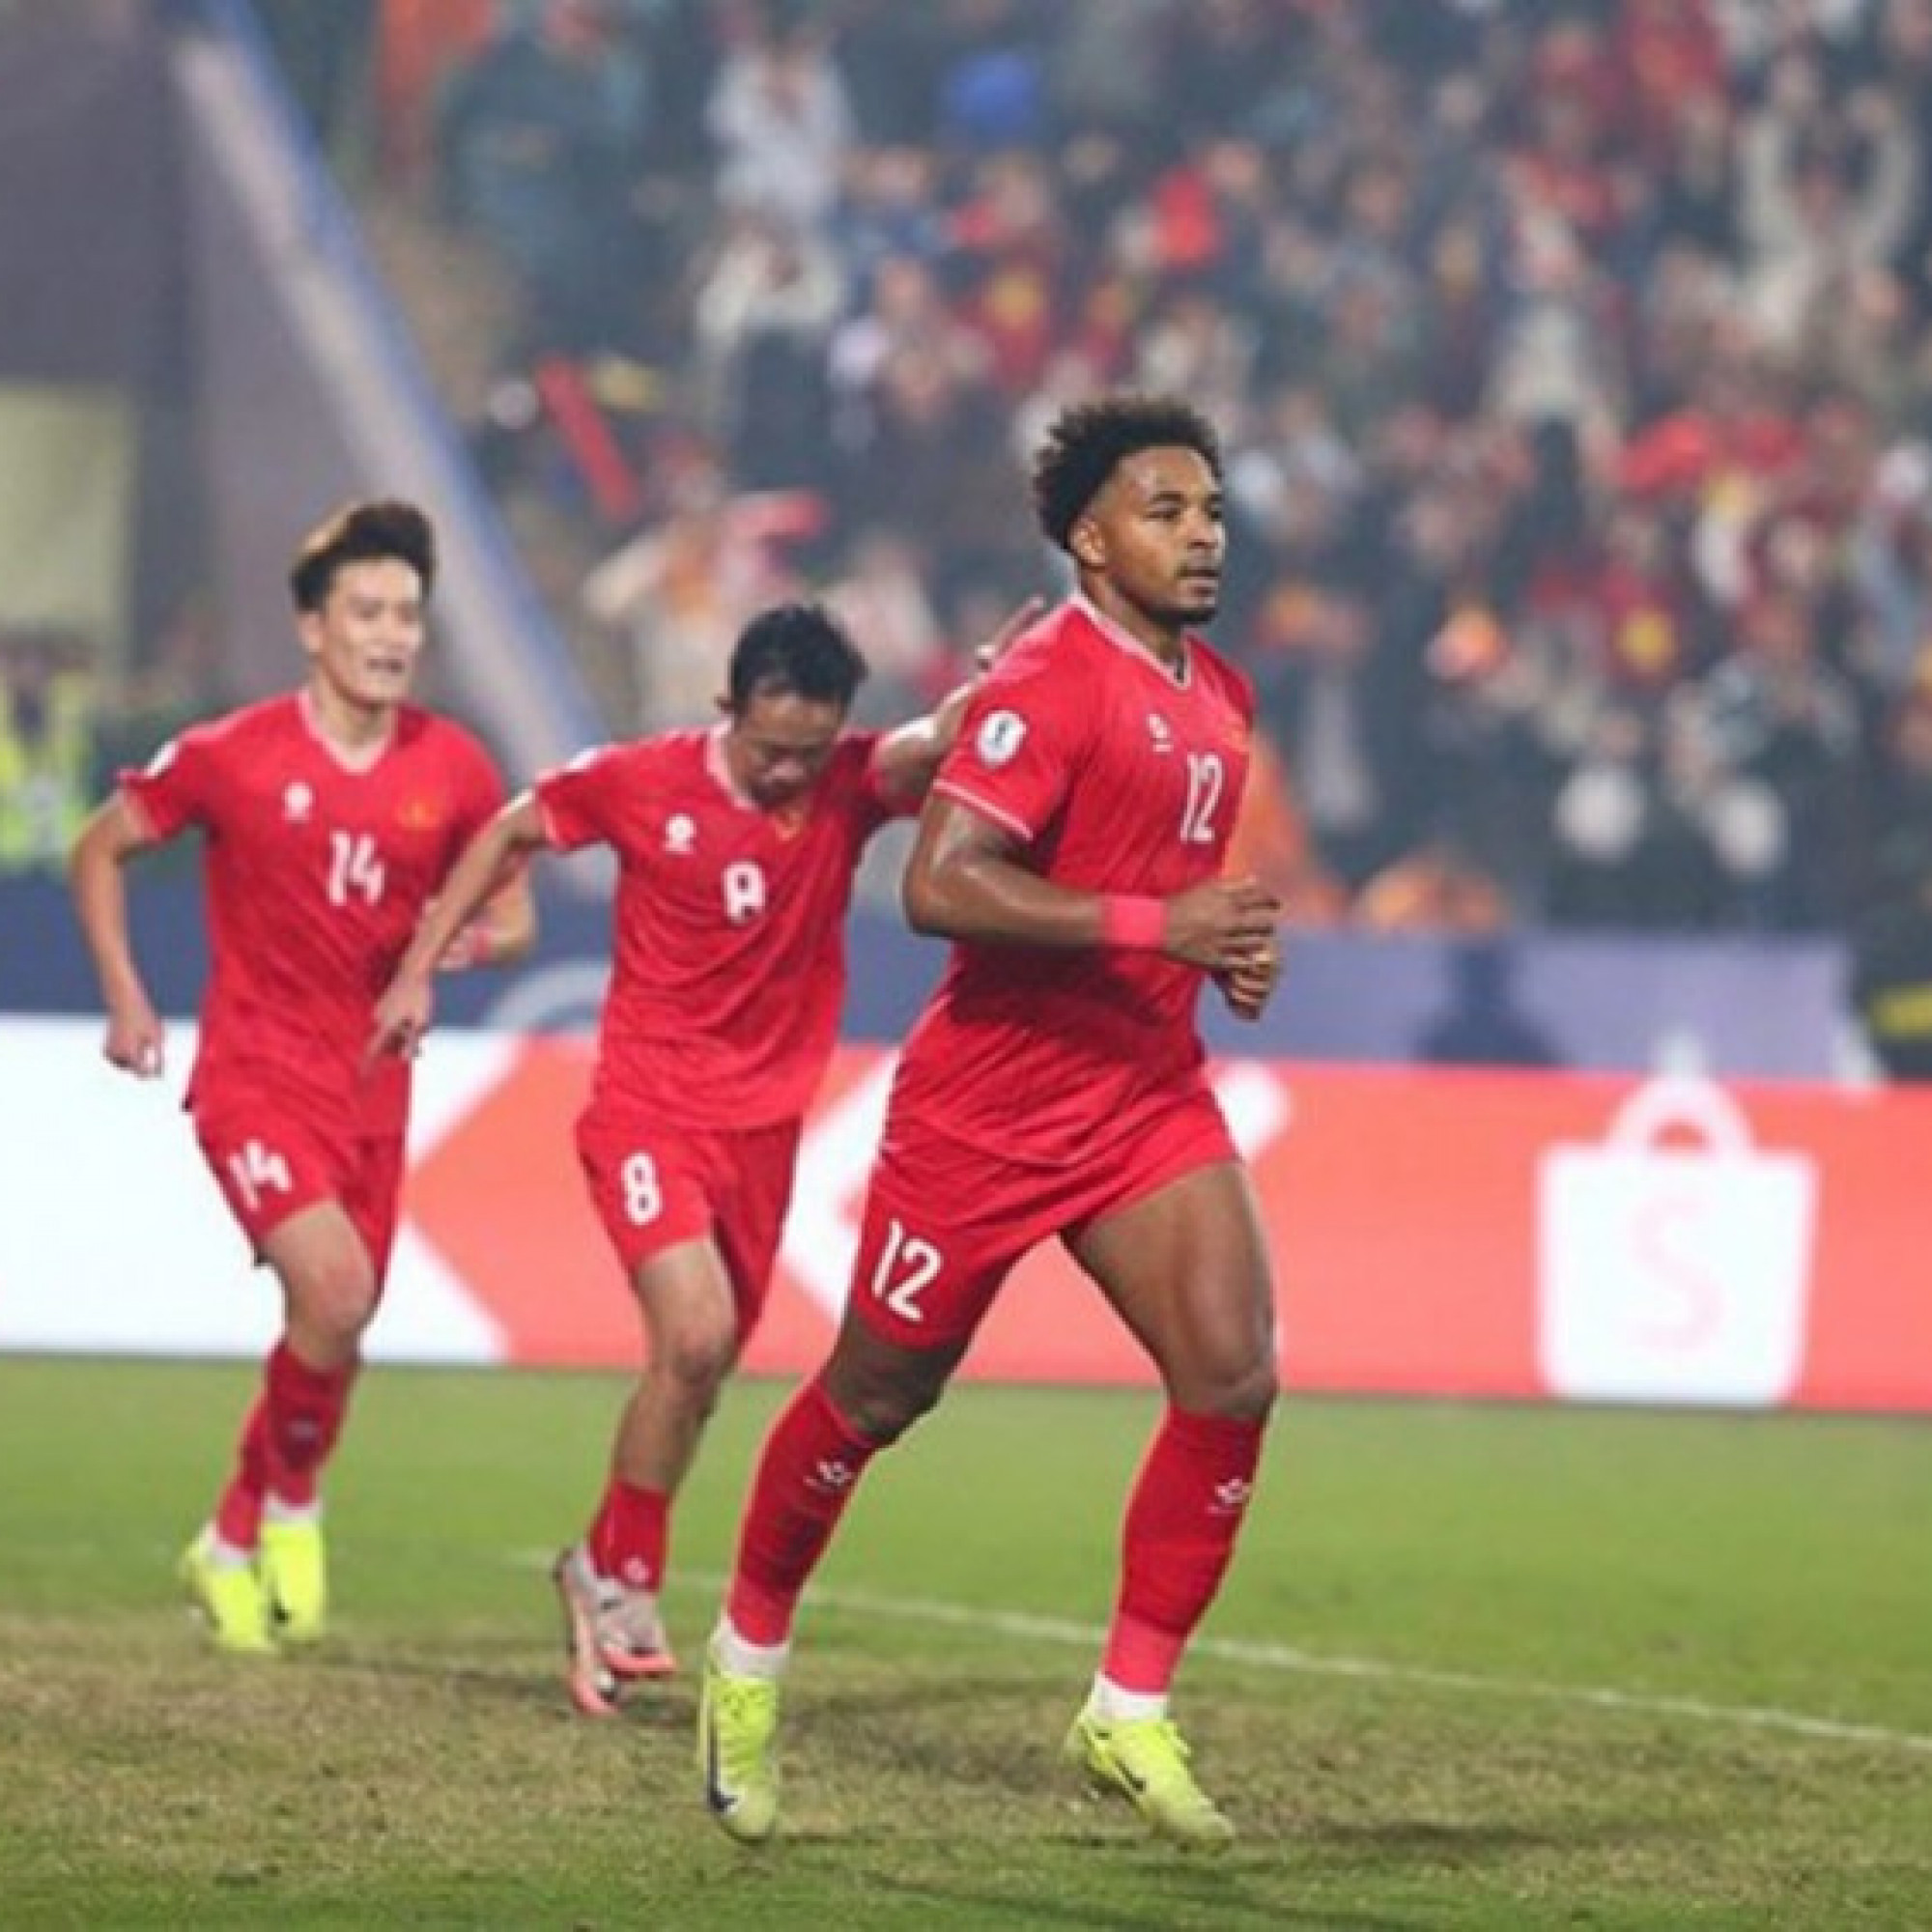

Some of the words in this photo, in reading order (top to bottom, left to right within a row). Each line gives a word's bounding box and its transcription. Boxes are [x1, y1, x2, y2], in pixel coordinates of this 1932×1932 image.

[1180, 752, 1224, 841] 12
[328, 831, 385, 906] 14
[722, 860, 767, 924] 8
[228, 1139, 292, 1211] 14
[620, 1150, 664, 1226] 8
[871, 1217, 943, 1322] 12
[1625, 1194, 1725, 1352] S
